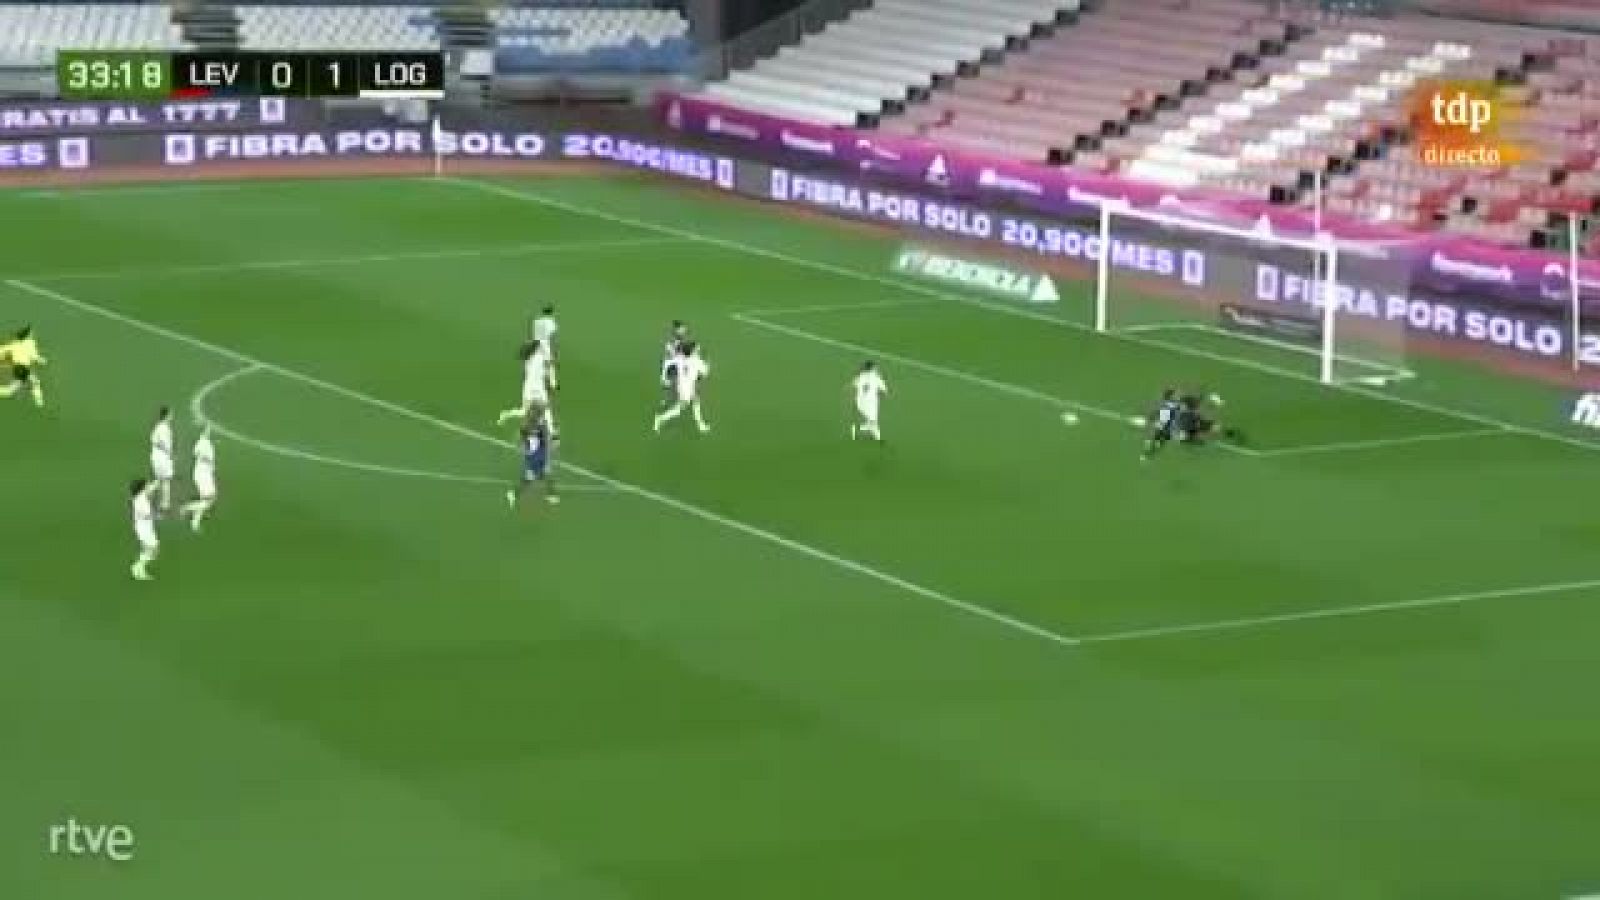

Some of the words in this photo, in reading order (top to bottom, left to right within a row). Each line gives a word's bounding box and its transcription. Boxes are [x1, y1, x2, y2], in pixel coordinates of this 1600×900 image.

[106, 105, 147, 123] AL
[162, 101, 240, 122] 1777
[205, 133, 326, 159] FIBRA
[336, 129, 421, 153] POR
[434, 131, 545, 156] SOLO
[792, 174, 862, 211] FIBRA
[867, 190, 919, 221] POR
[924, 202, 991, 238] SOLO
[1284, 276, 1379, 317] FIBRA
[1387, 296, 1456, 332] POR
[1465, 311, 1562, 355] SOLO
